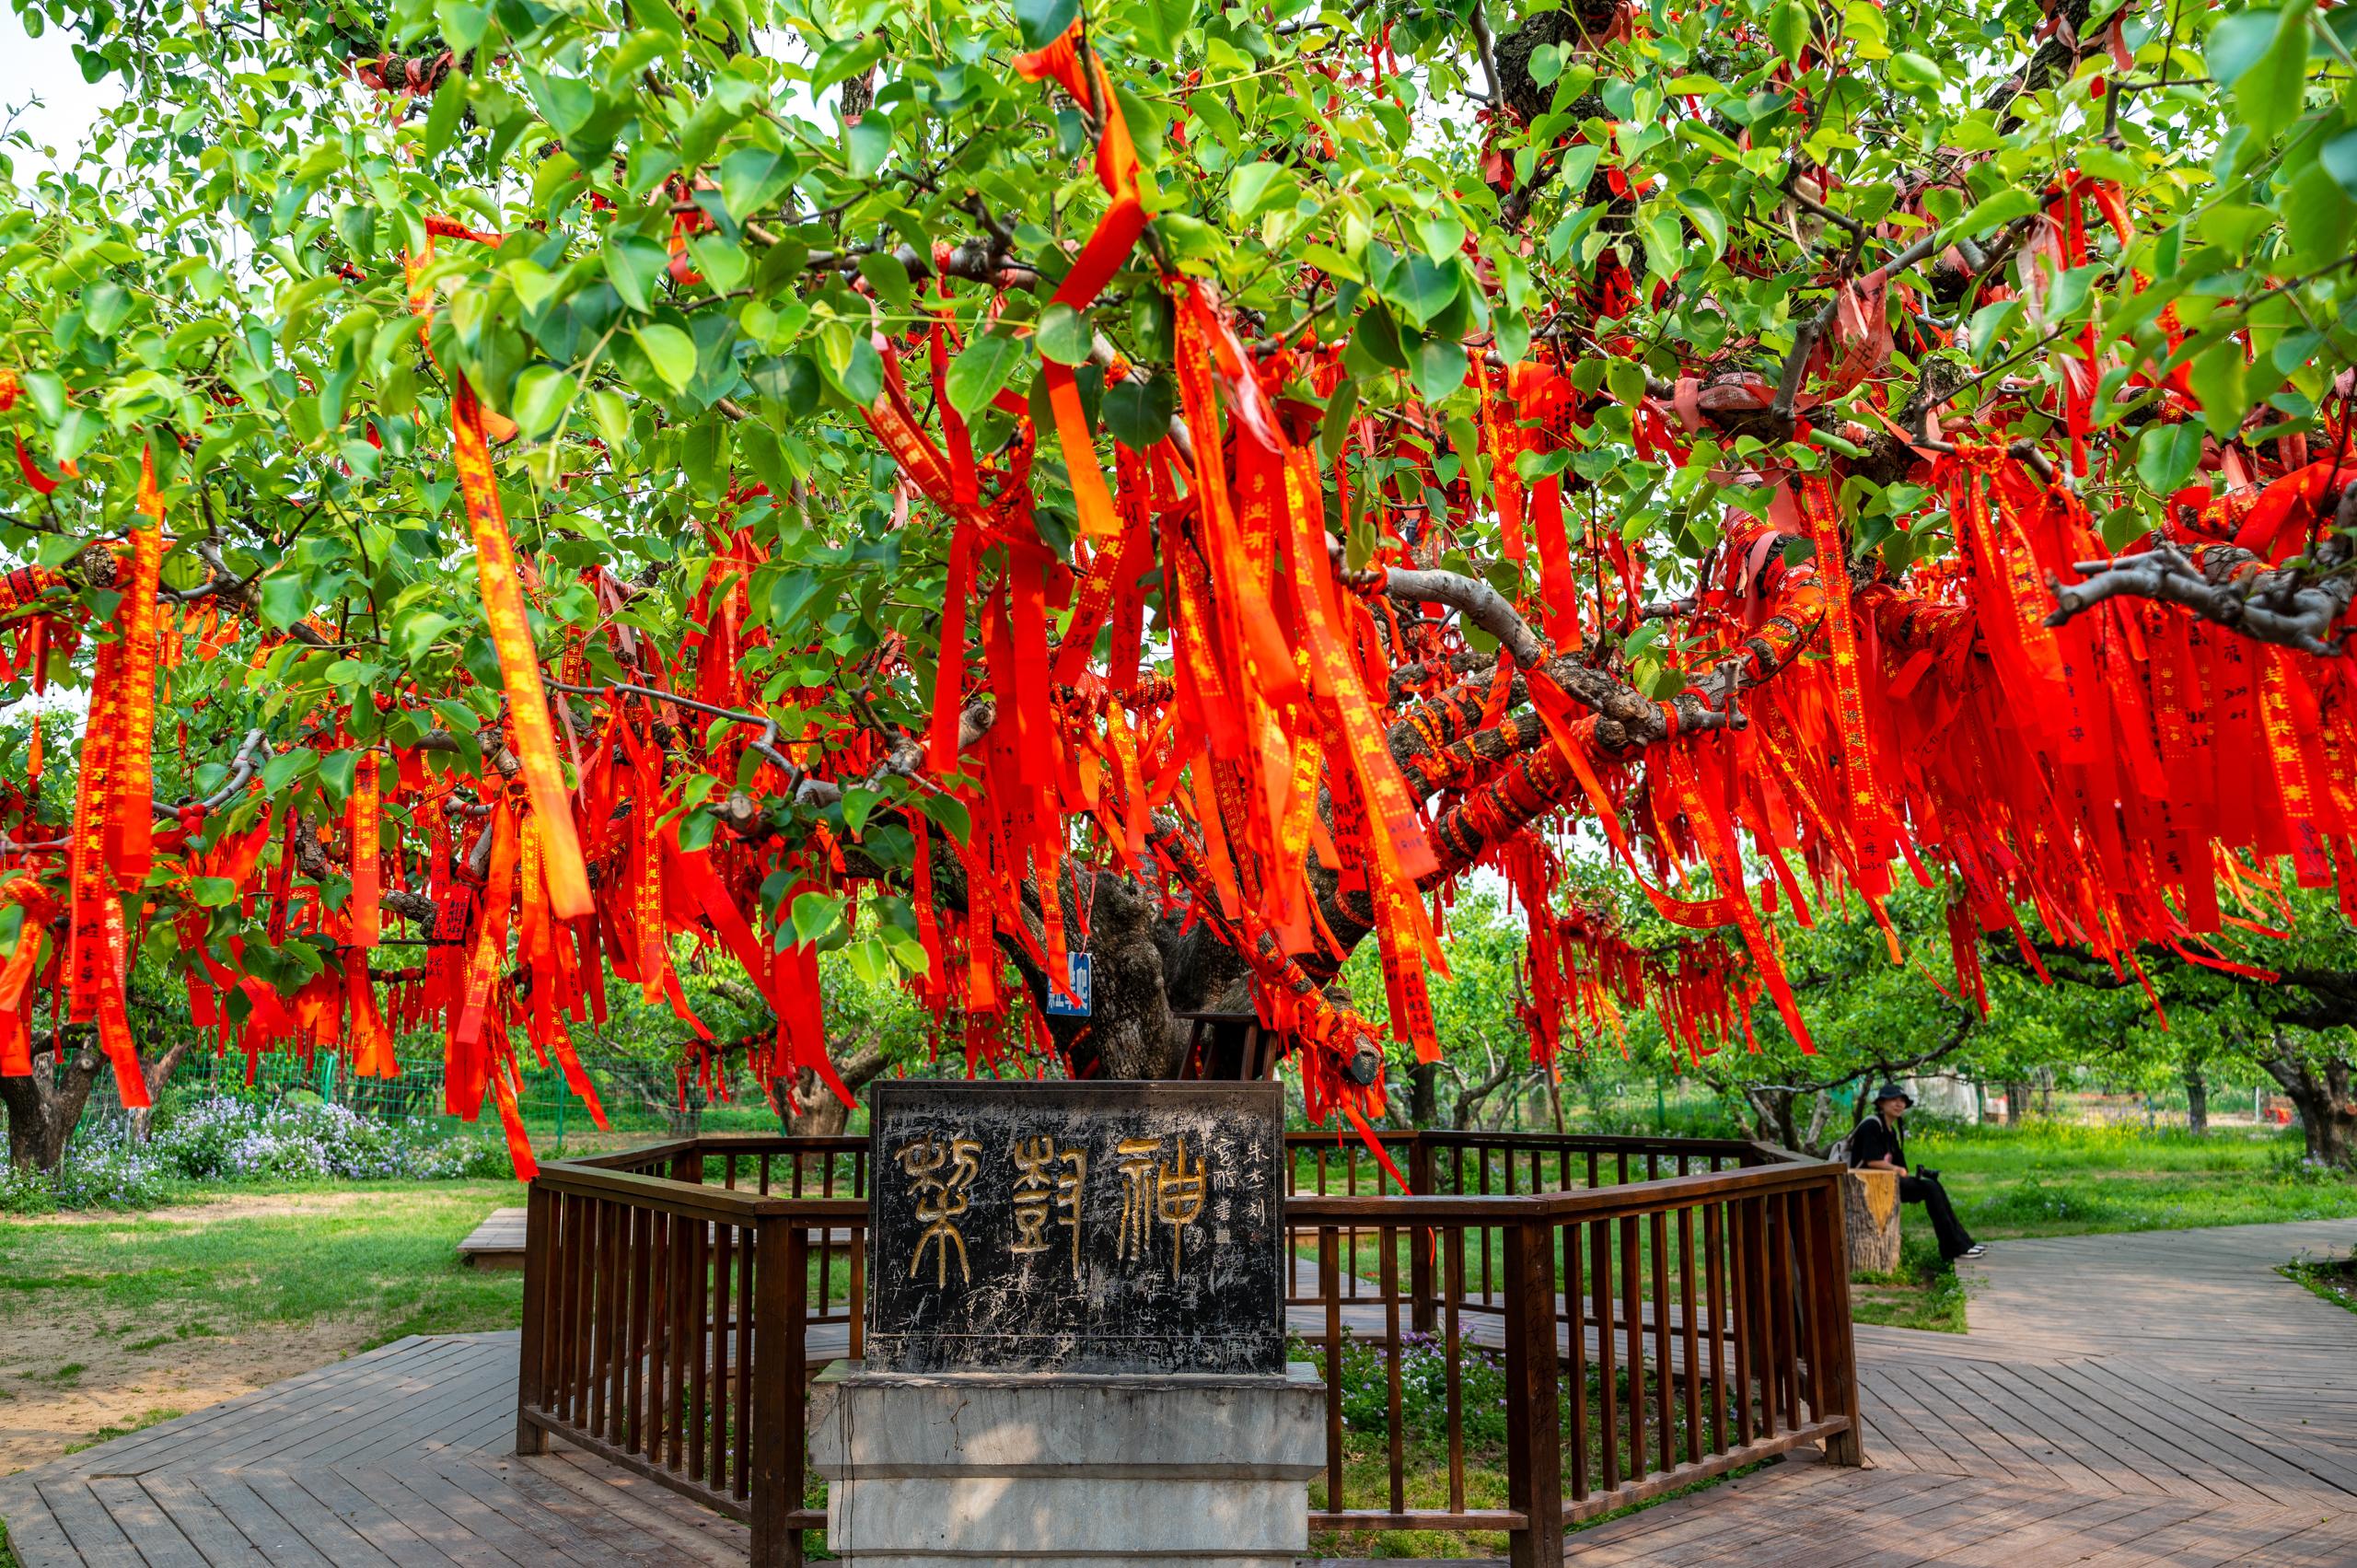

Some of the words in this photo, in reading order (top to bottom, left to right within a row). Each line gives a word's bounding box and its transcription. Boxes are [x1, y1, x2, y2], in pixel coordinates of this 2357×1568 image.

[1825, 552, 1847, 633] 学业有成
[1840, 687, 1867, 772] 金榜题名
[2264, 667, 2298, 762] 生意兴隆
